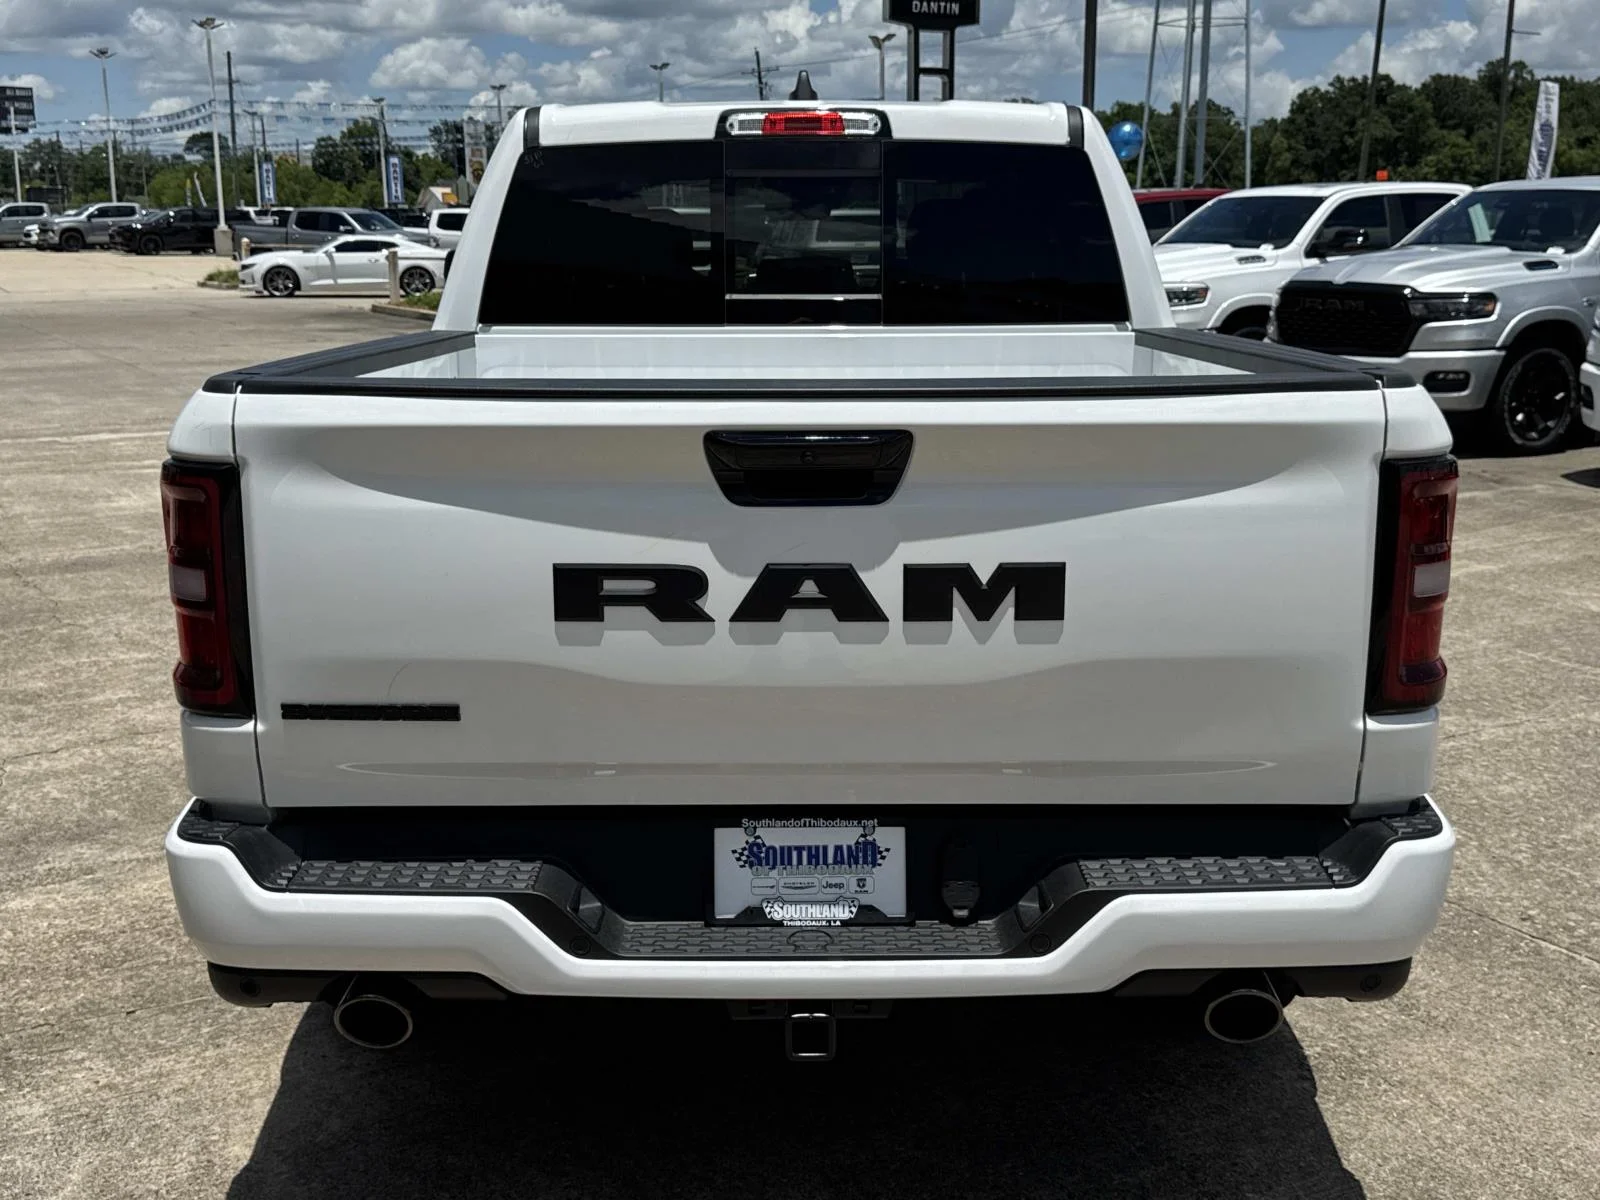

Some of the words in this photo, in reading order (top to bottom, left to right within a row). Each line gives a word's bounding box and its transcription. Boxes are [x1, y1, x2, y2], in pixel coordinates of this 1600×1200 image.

[912, 1, 960, 15] DANTIN
[553, 562, 1067, 622] RAM
[741, 818, 878, 828] SouthlandofThibodaux.net
[748, 841, 878, 869] SOUTHLAND
[822, 881, 845, 890] Jeep
[773, 901, 850, 919] SOUTHLAND
